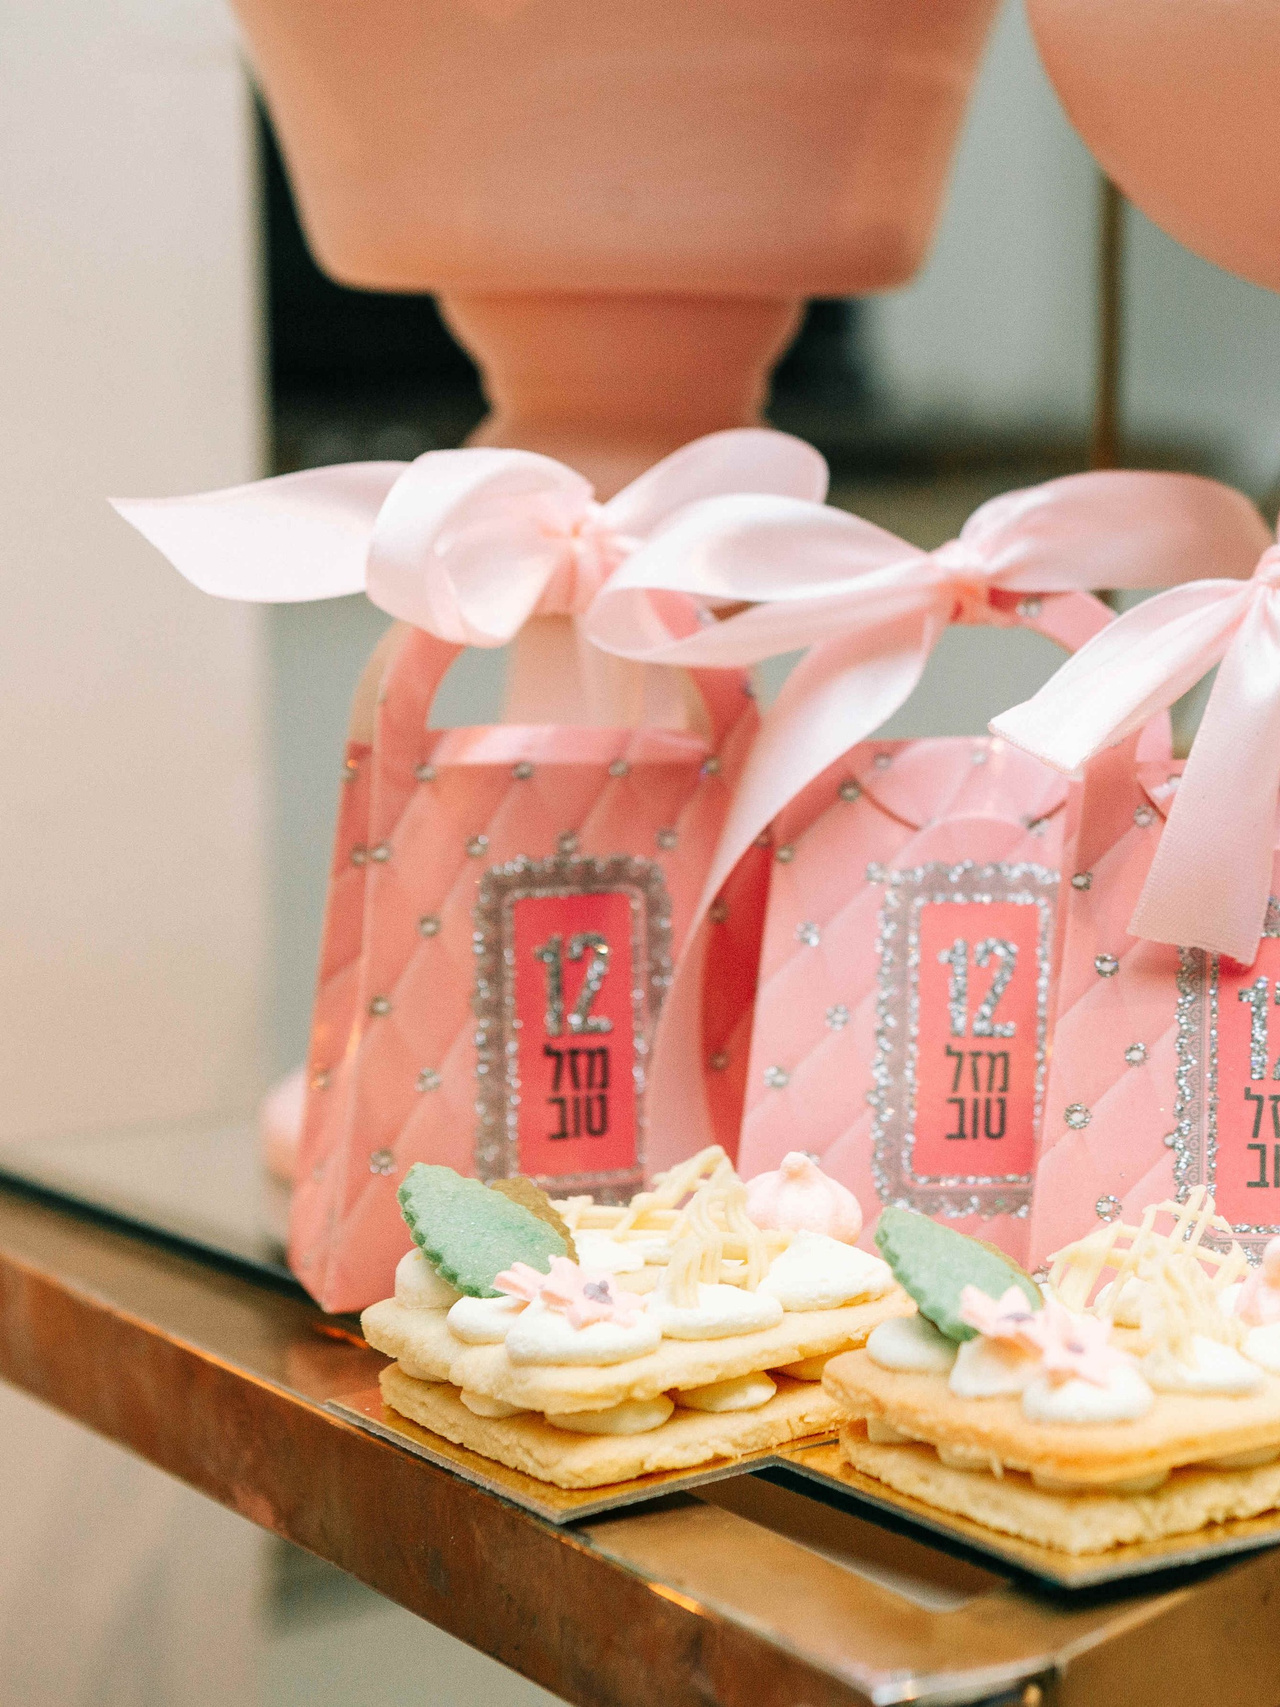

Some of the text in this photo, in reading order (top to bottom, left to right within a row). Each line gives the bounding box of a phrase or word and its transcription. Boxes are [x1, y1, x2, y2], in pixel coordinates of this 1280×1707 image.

[534, 933, 612, 1035] 12
[937, 938, 1019, 1037] 12
[543, 1044, 609, 1092] מזל
[945, 1043, 1010, 1093] מזל
[547, 1094, 608, 1140] טוב
[946, 1097, 1006, 1140] טוב
